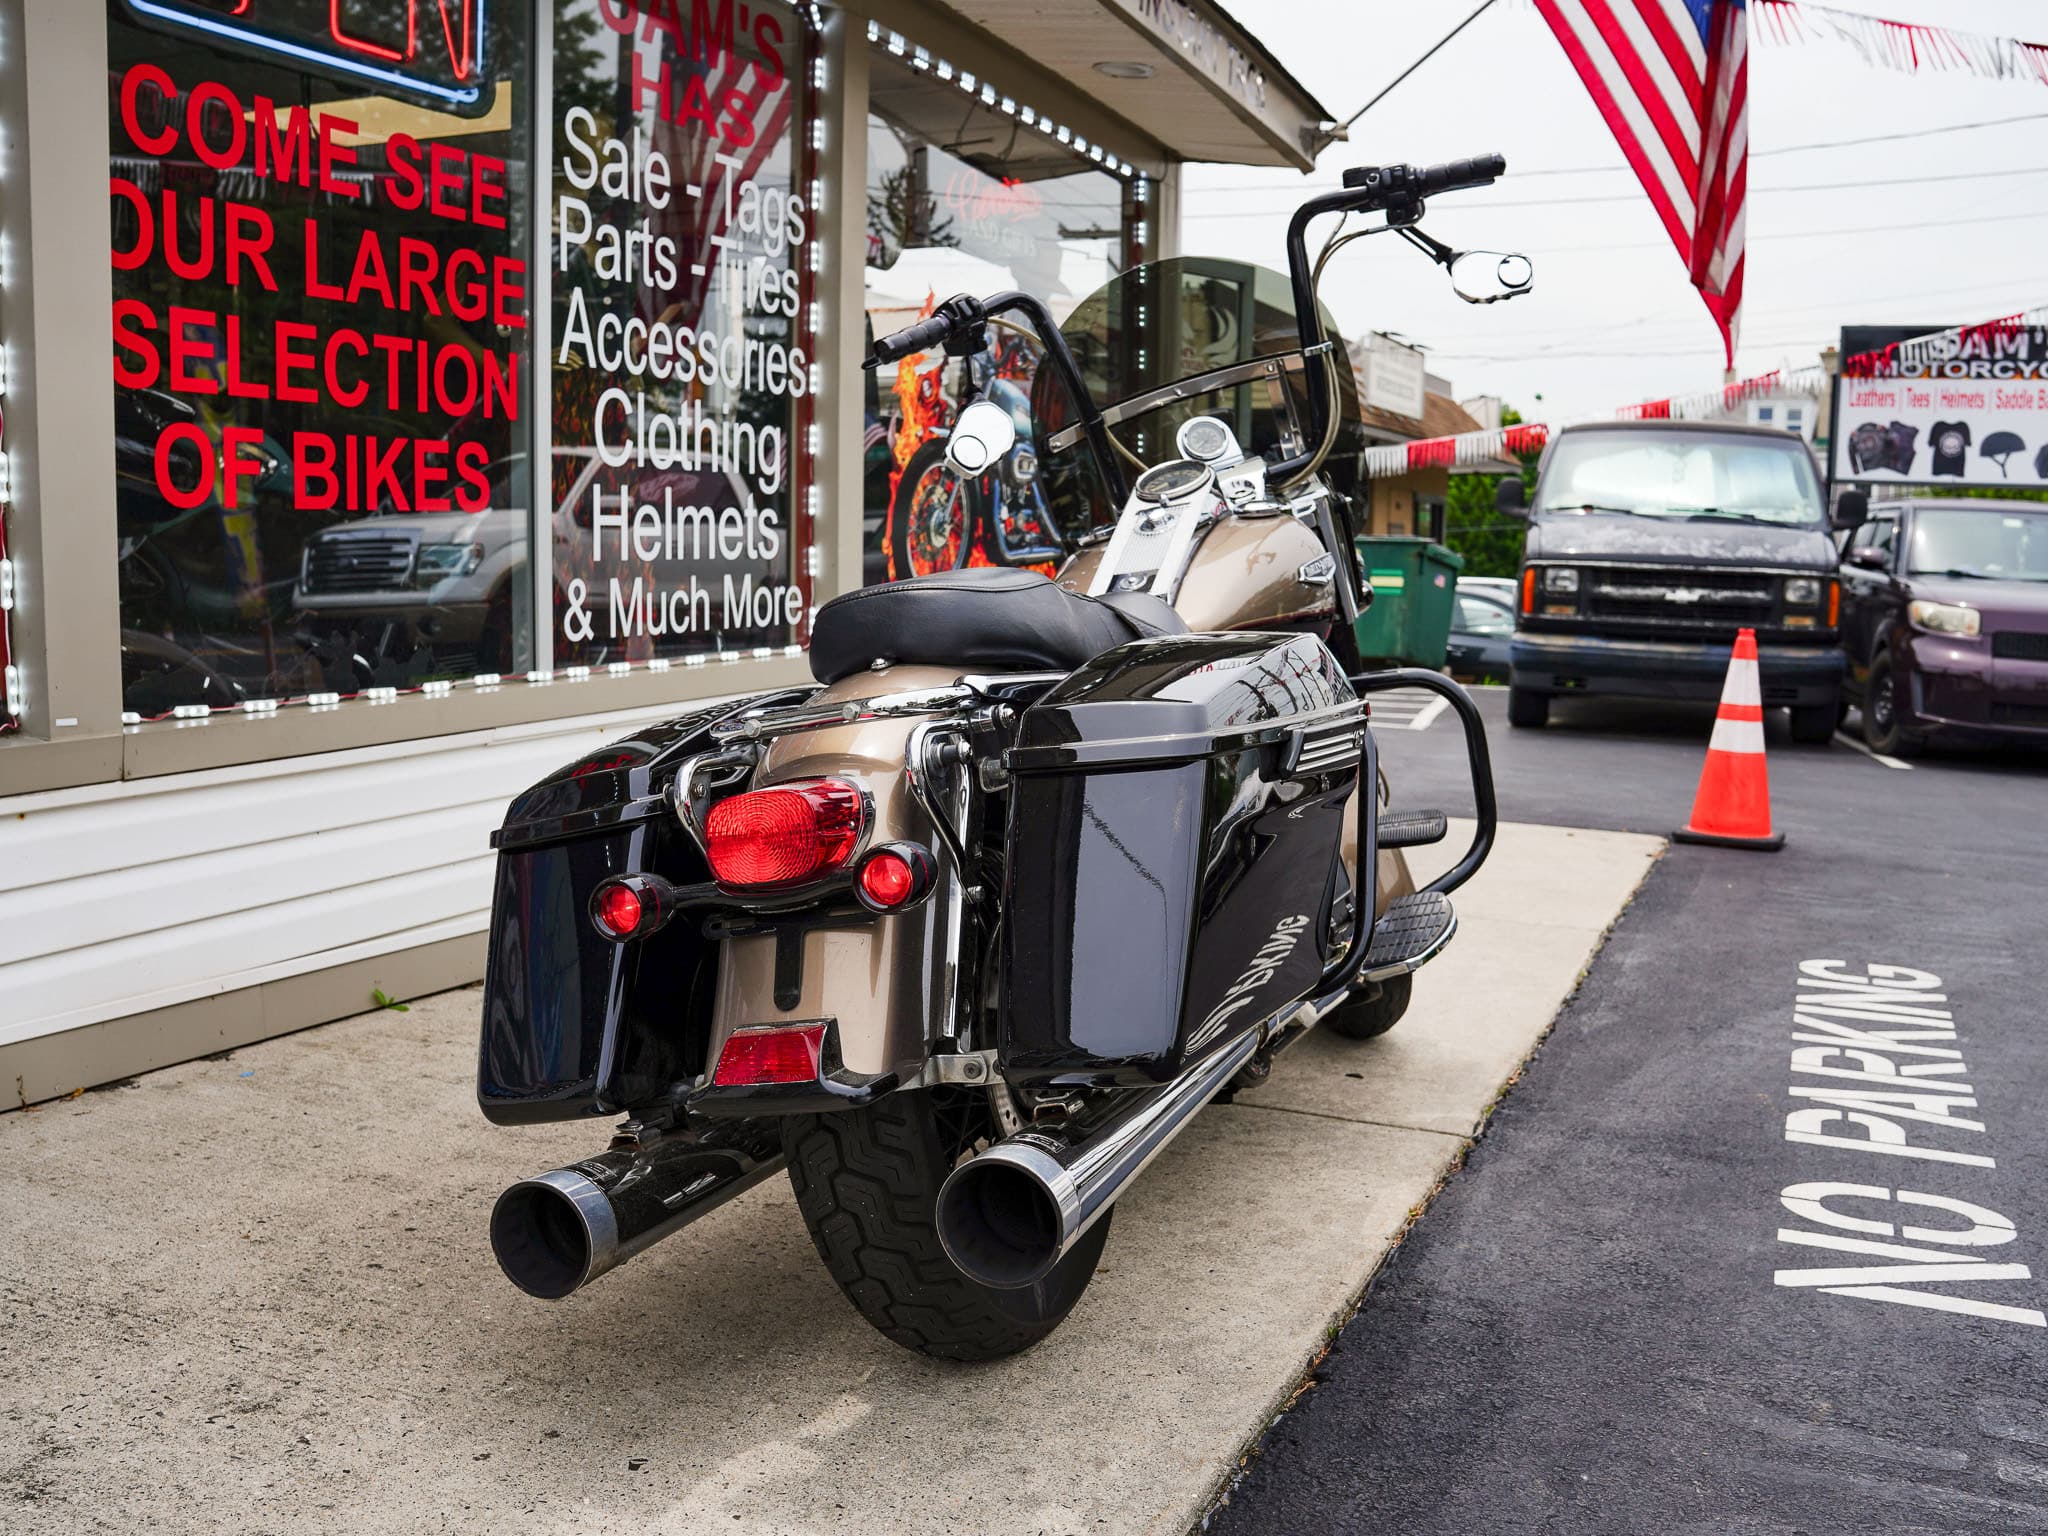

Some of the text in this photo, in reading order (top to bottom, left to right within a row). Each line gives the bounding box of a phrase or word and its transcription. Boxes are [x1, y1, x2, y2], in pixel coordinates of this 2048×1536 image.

[120, 63, 507, 230] COME SEE
[631, 50, 756, 148] HAS
[563, 106, 671, 210] Sale
[715, 152, 806, 258] Tags
[110, 177, 527, 330] OUR LARGE
[560, 195, 678, 291] Parts
[710, 234, 801, 318] Tires
[112, 299, 519, 421] SELECTION
[558, 286, 806, 398] Accessories
[153, 421, 491, 514] OF BIKES
[594, 387, 782, 495] Clothing
[592, 483, 780, 562] Helmets
[563, 573, 803, 642] & Much More
[1773, 958, 2048, 1328] NO PARKING
